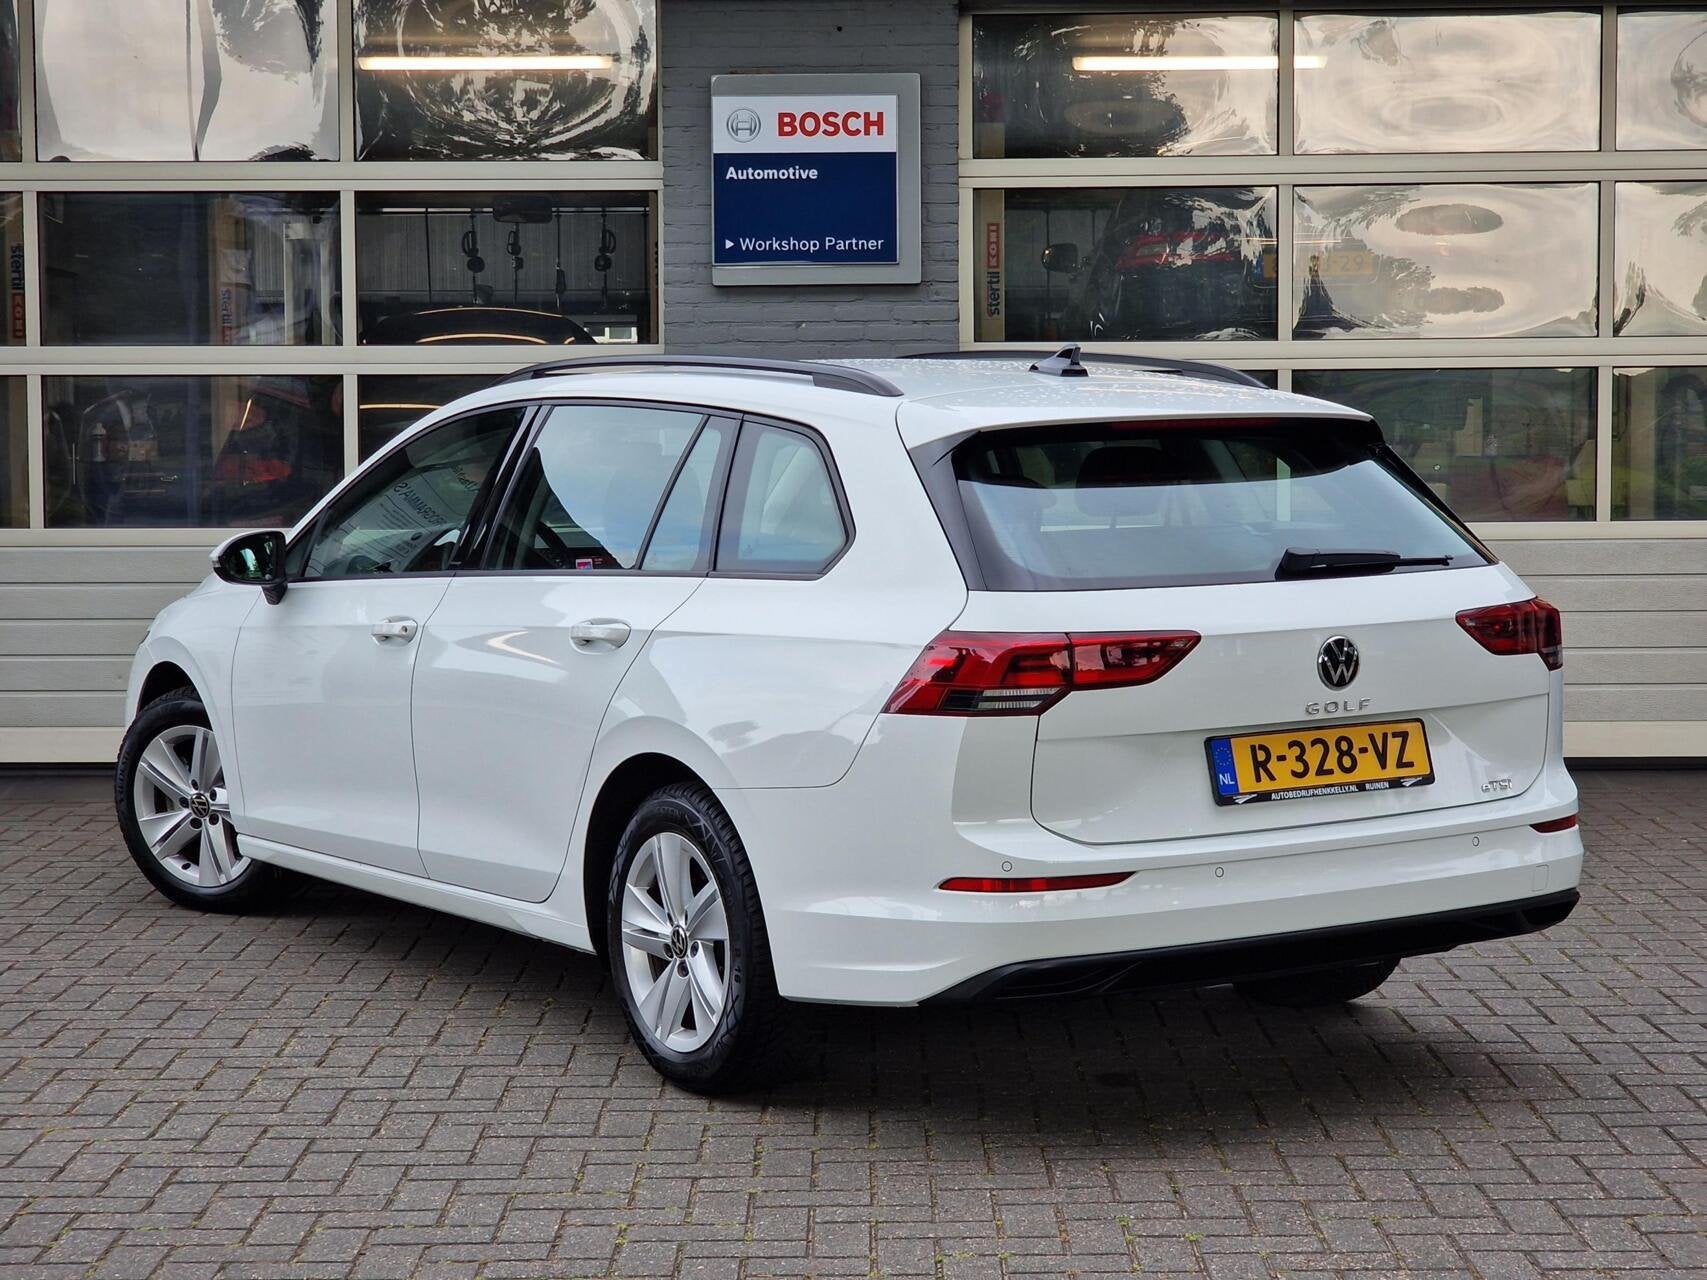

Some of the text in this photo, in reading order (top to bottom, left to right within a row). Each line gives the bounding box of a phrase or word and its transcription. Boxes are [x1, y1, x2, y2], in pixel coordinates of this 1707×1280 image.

[777, 111, 884, 137] BOSCH
[725, 166, 818, 180] Automotive
[740, 236, 884, 253] Workshop Partner
[986, 271, 1000, 315] stertil
[1305, 698, 1371, 715] GOLF
[1219, 730, 1415, 785] NL R-328-VZ
[1271, 781, 1389, 800] AUTOBEDRIJFHENKKELLY.NL RUINEN
[1481, 779, 1512, 793] eTSI
